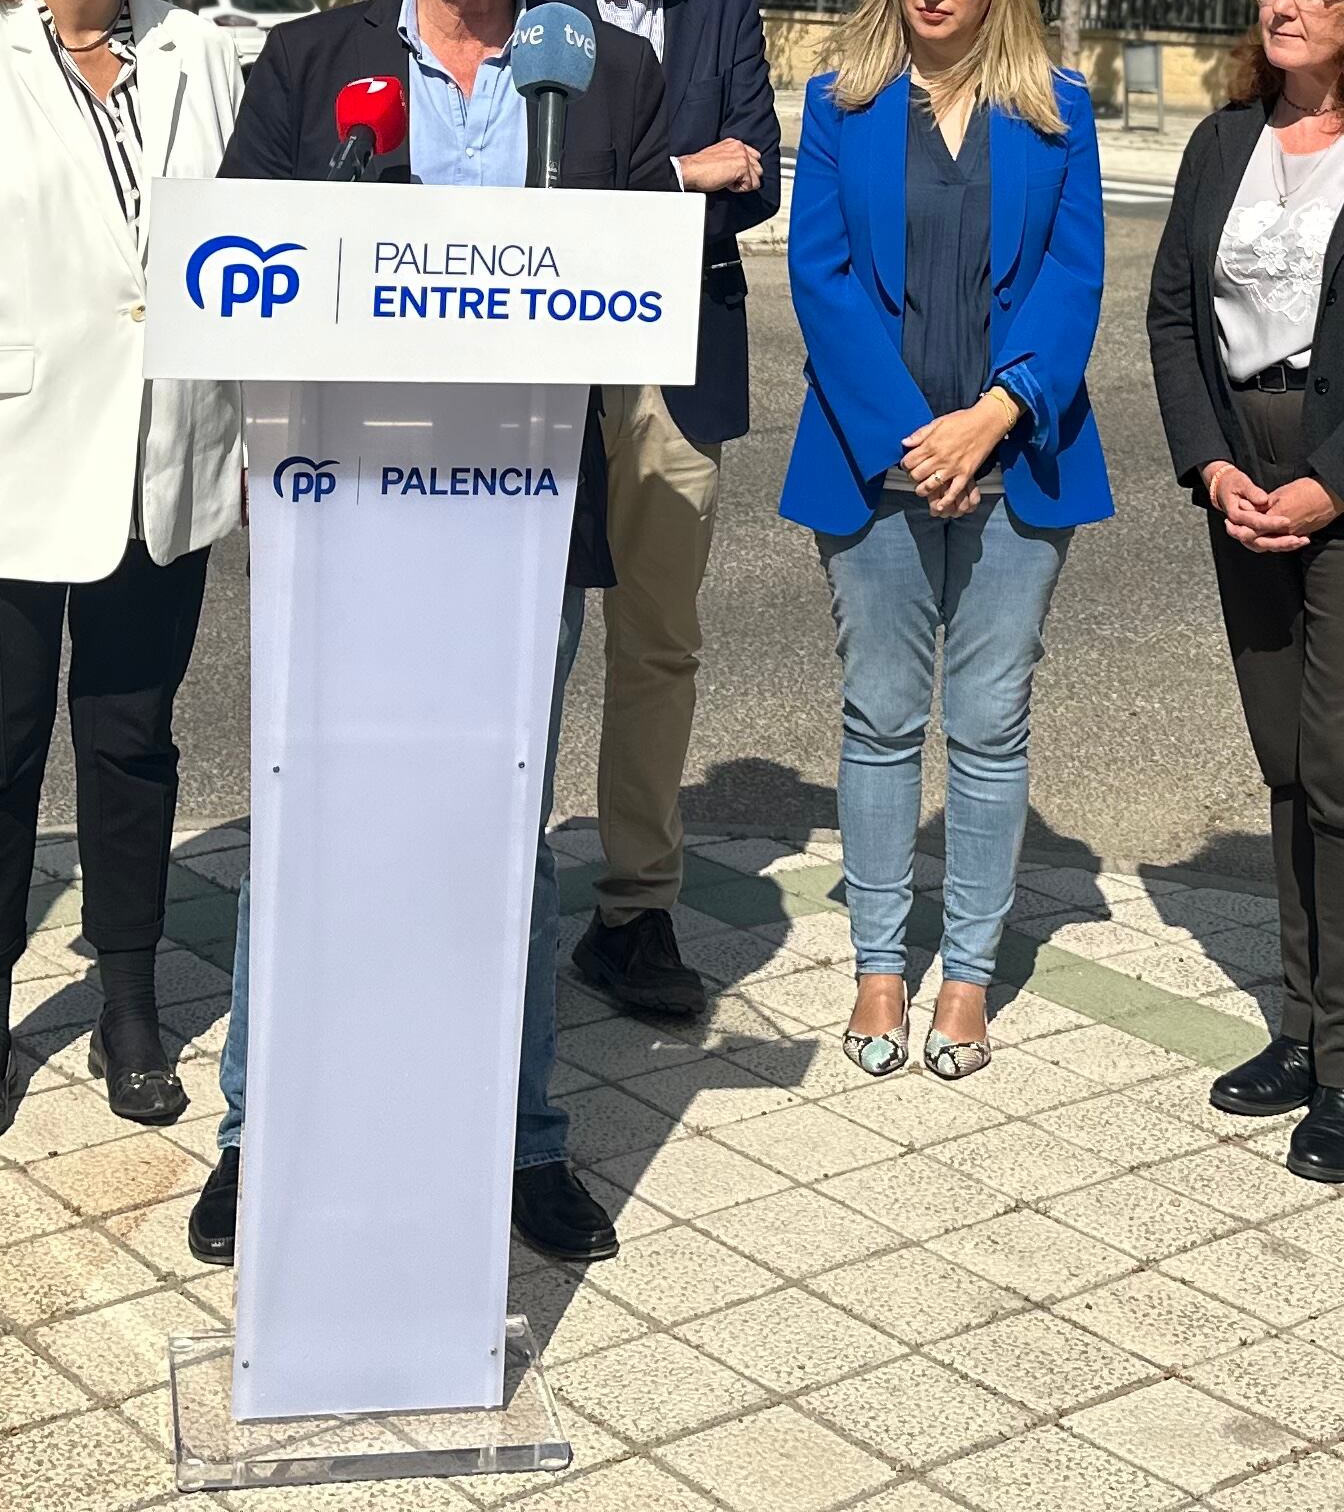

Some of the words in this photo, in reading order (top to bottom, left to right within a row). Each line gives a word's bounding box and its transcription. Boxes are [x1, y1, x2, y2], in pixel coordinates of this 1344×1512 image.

[564, 24, 595, 59] tve
[374, 242, 560, 278] PALENCIA
[373, 285, 511, 320] ENTRE
[520, 288, 663, 323] TODOS
[381, 466, 559, 496] PALENCIA
